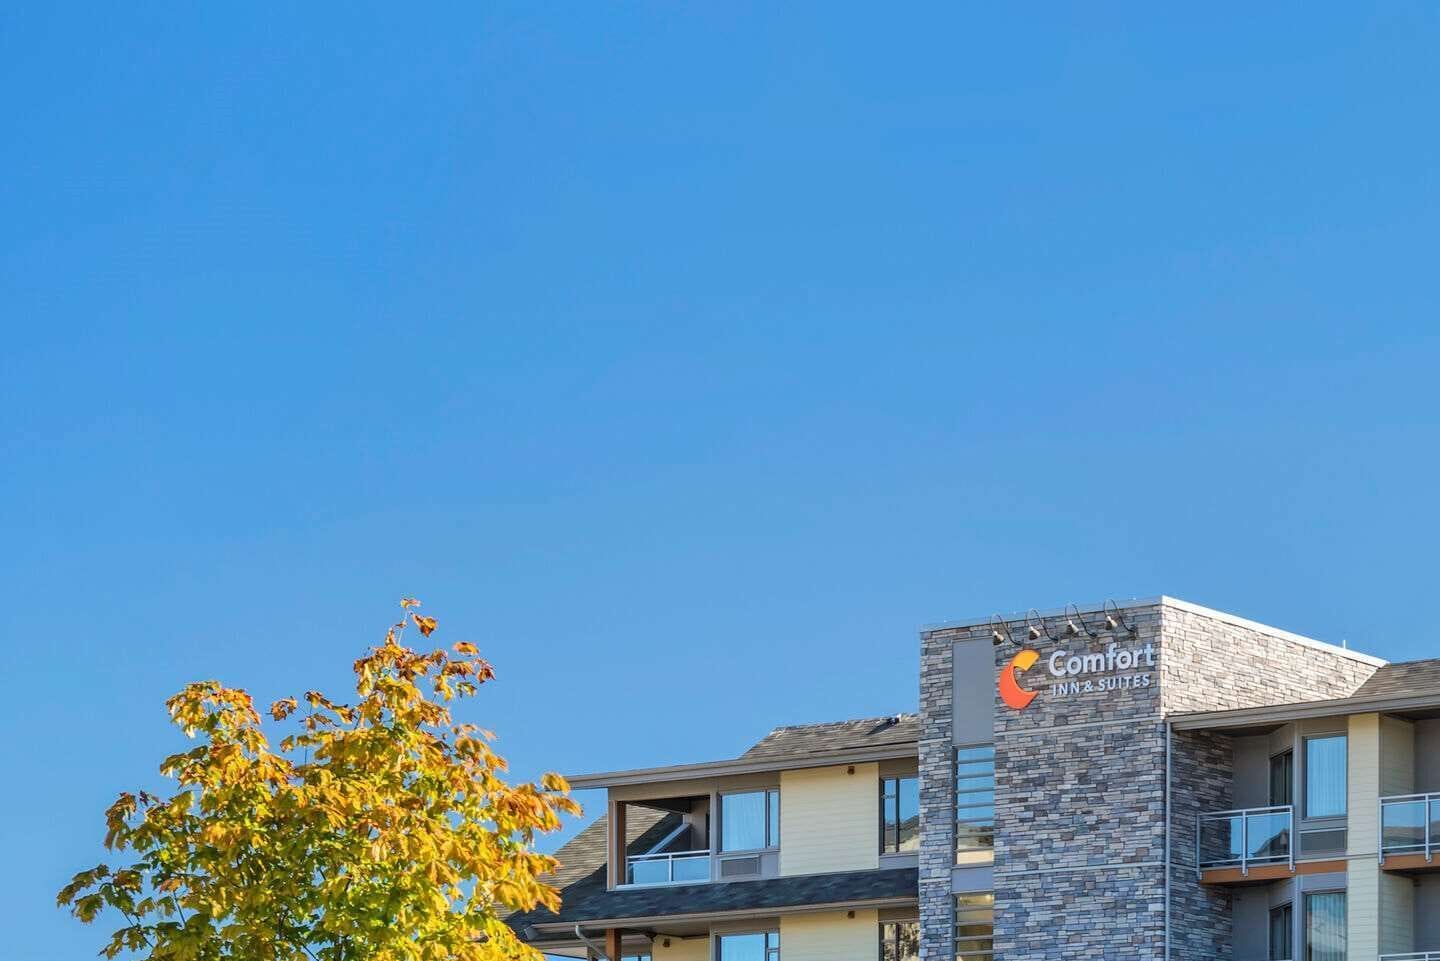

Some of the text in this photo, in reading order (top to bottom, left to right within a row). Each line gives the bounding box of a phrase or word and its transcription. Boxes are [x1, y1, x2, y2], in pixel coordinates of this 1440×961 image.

[1048, 643, 1155, 677] Comfort
[1052, 673, 1150, 696] INN & SUITES
